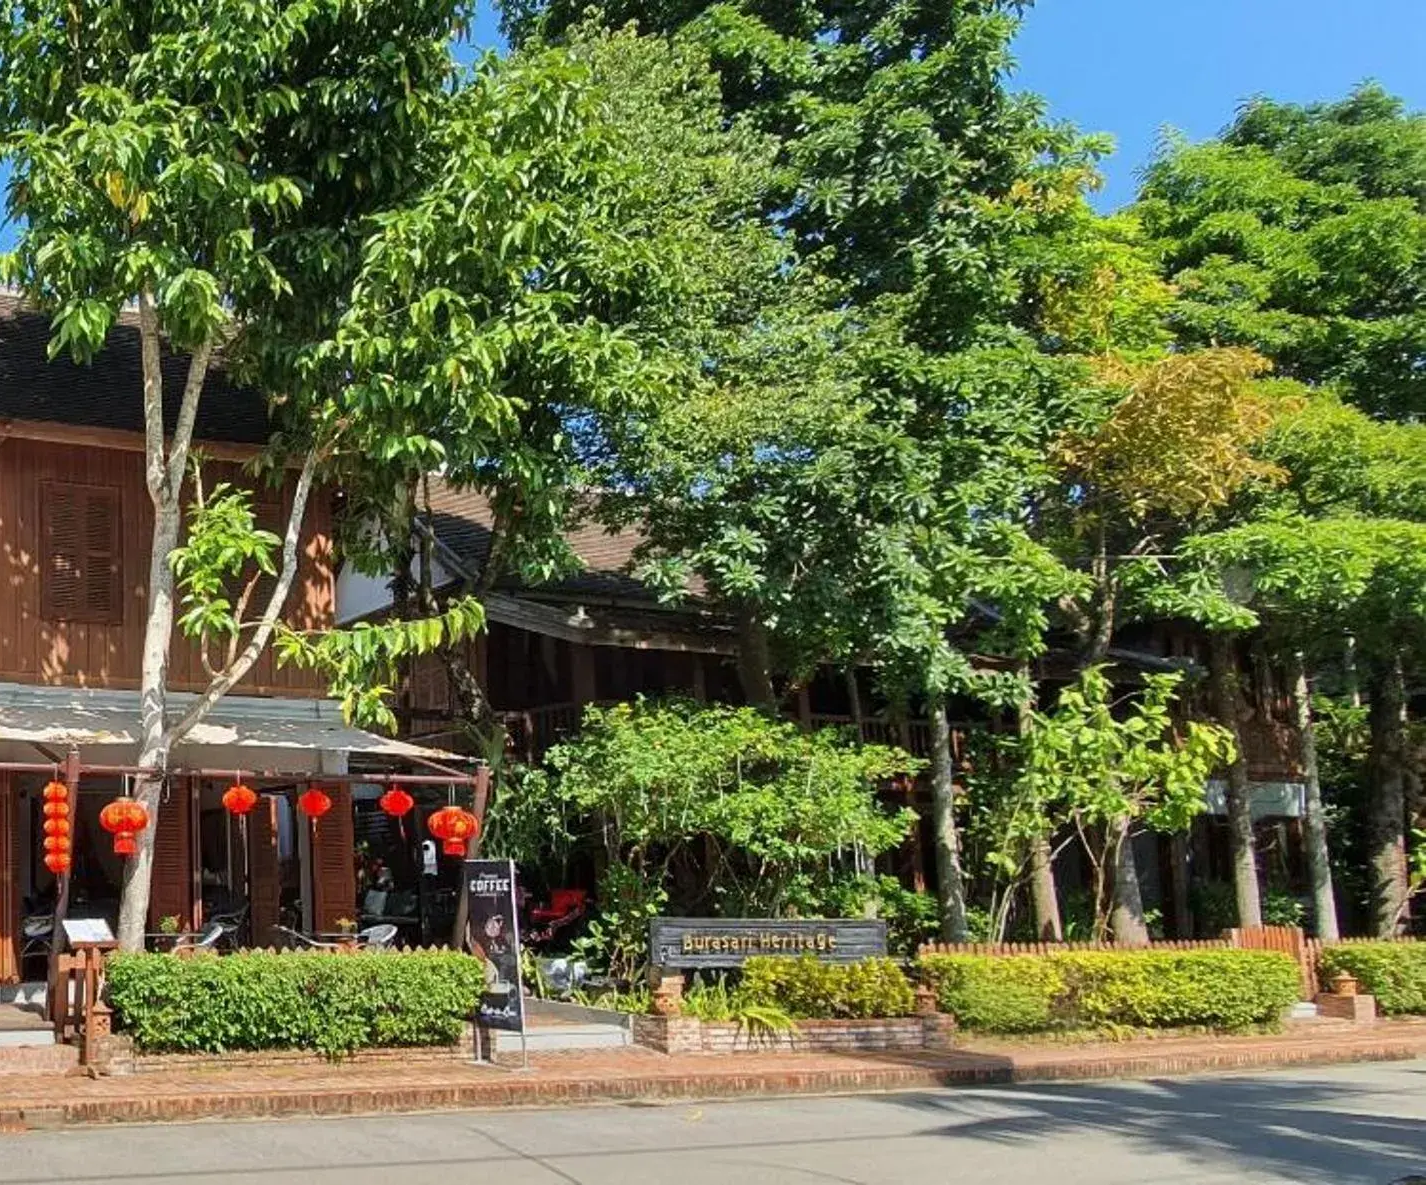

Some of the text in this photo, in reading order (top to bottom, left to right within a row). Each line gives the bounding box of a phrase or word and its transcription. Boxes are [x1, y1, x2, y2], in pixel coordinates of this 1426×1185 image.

[469, 879, 510, 892] COFFEE
[682, 931, 838, 951] Burasari Heritage
